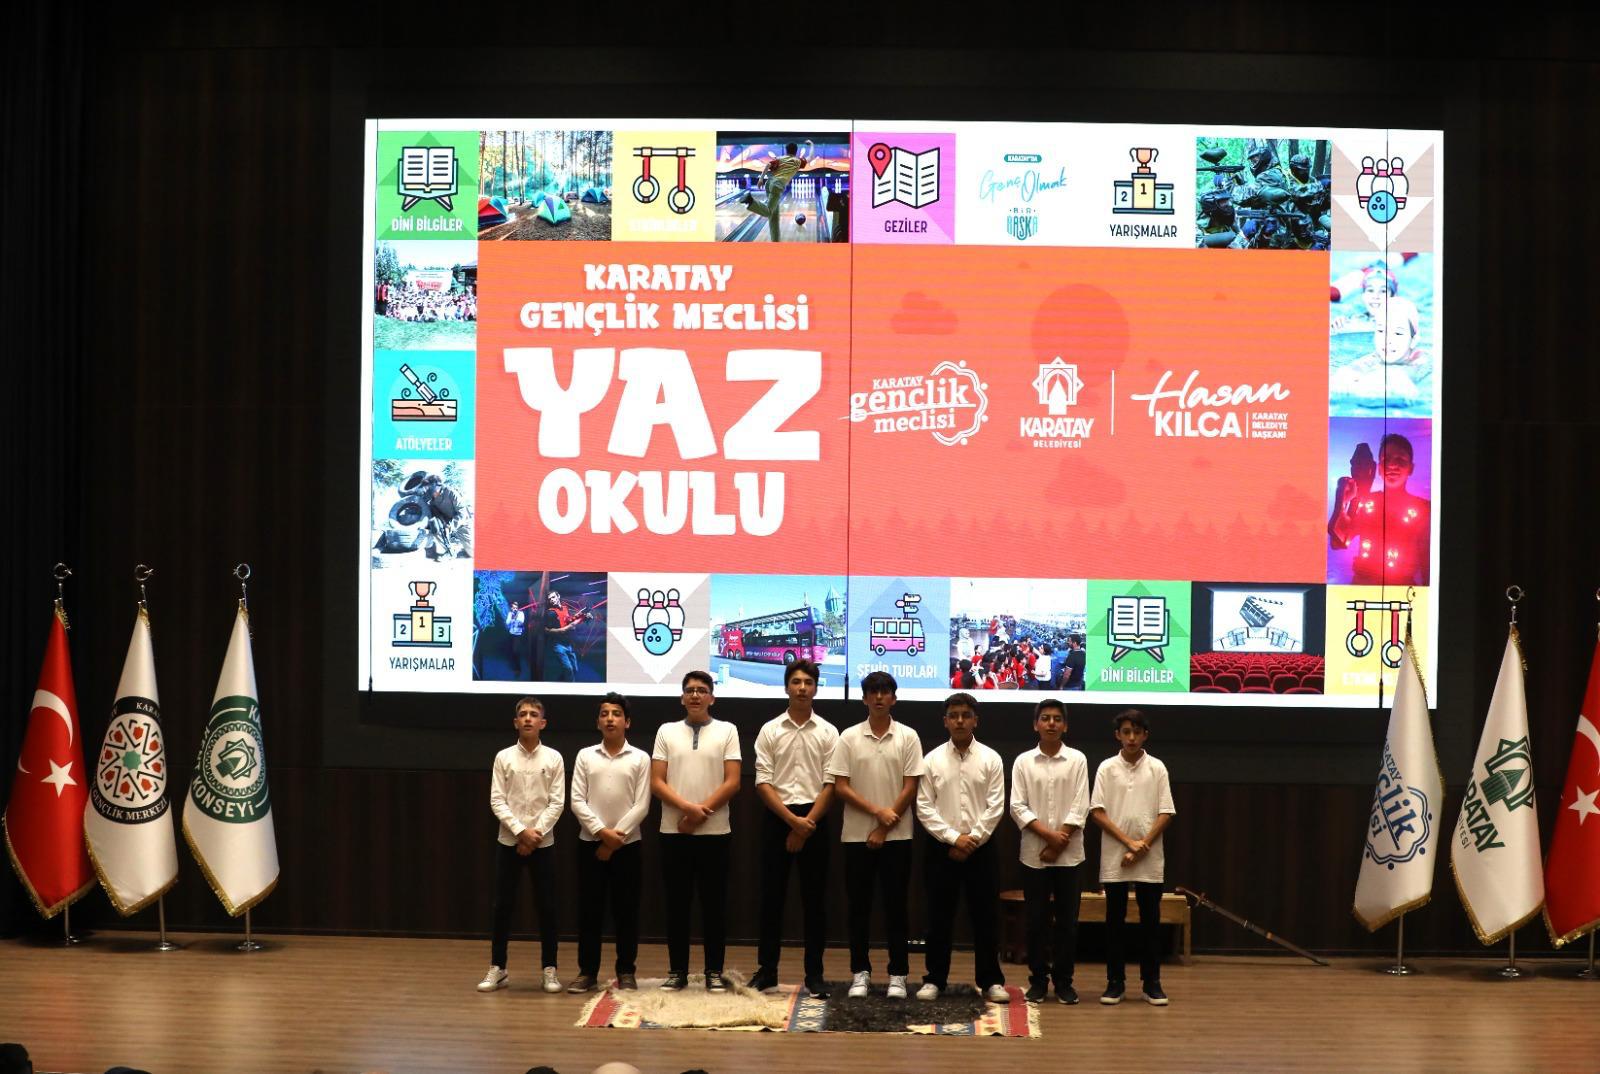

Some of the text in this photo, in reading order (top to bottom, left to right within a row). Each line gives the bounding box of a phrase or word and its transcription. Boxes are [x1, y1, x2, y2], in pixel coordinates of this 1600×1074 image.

[1141, 182, 1147, 195] 1
[1121, 191, 1128, 202] 2
[1160, 193, 1167, 205] 3
[391, 216, 463, 231] DİNİ BİLGİLER
[884, 217, 928, 233] GEZİLER
[1109, 224, 1178, 239] YARIŞMALAR
[583, 264, 733, 292] KARATAY
[519, 292, 810, 337] GENÇLİK MECLİSİ
[872, 375, 924, 390] KARATAY
[1130, 370, 1290, 417] Hasan
[503, 346, 823, 462] YAZ
[873, 407, 956, 434] meclisi
[1154, 410, 1243, 438] KILCA
[1251, 412, 1289, 421] KARATAY
[1020, 416, 1095, 439] KARATAY
[396, 435, 453, 451] ATÖLYELER
[538, 467, 785, 537] OKULU
[400, 623, 407, 635] 2
[419, 615, 426, 628] 1
[438, 627, 445, 638] 3
[389, 657, 455, 672] YARIŞMALAR
[891, 664, 938, 679] TURLARI
[1101, 666, 1174, 684] DİNİ BİLGİLER
